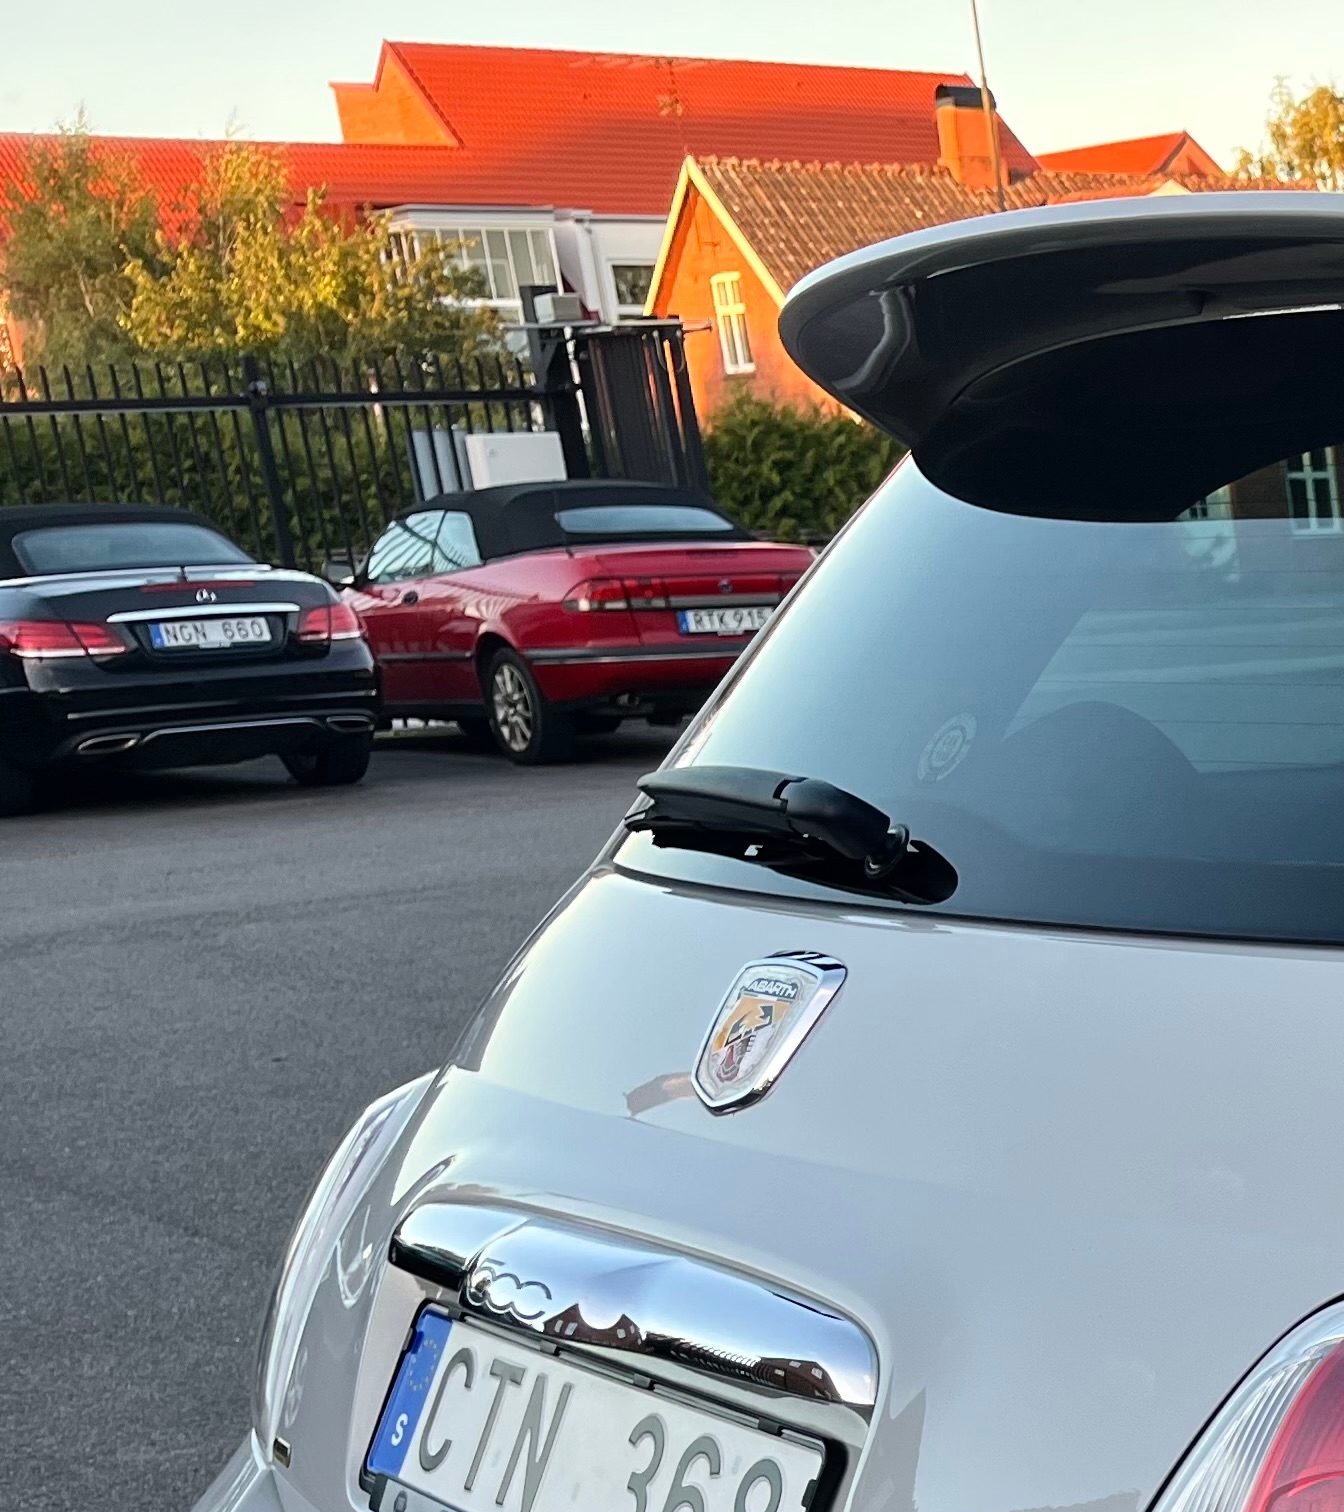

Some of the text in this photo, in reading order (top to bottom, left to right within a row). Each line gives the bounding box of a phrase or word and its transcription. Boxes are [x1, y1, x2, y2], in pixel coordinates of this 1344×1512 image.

[164, 620, 263, 643] NGN 660
[748, 980, 798, 998] ABARTH
[390, 1413, 409, 1447] S
